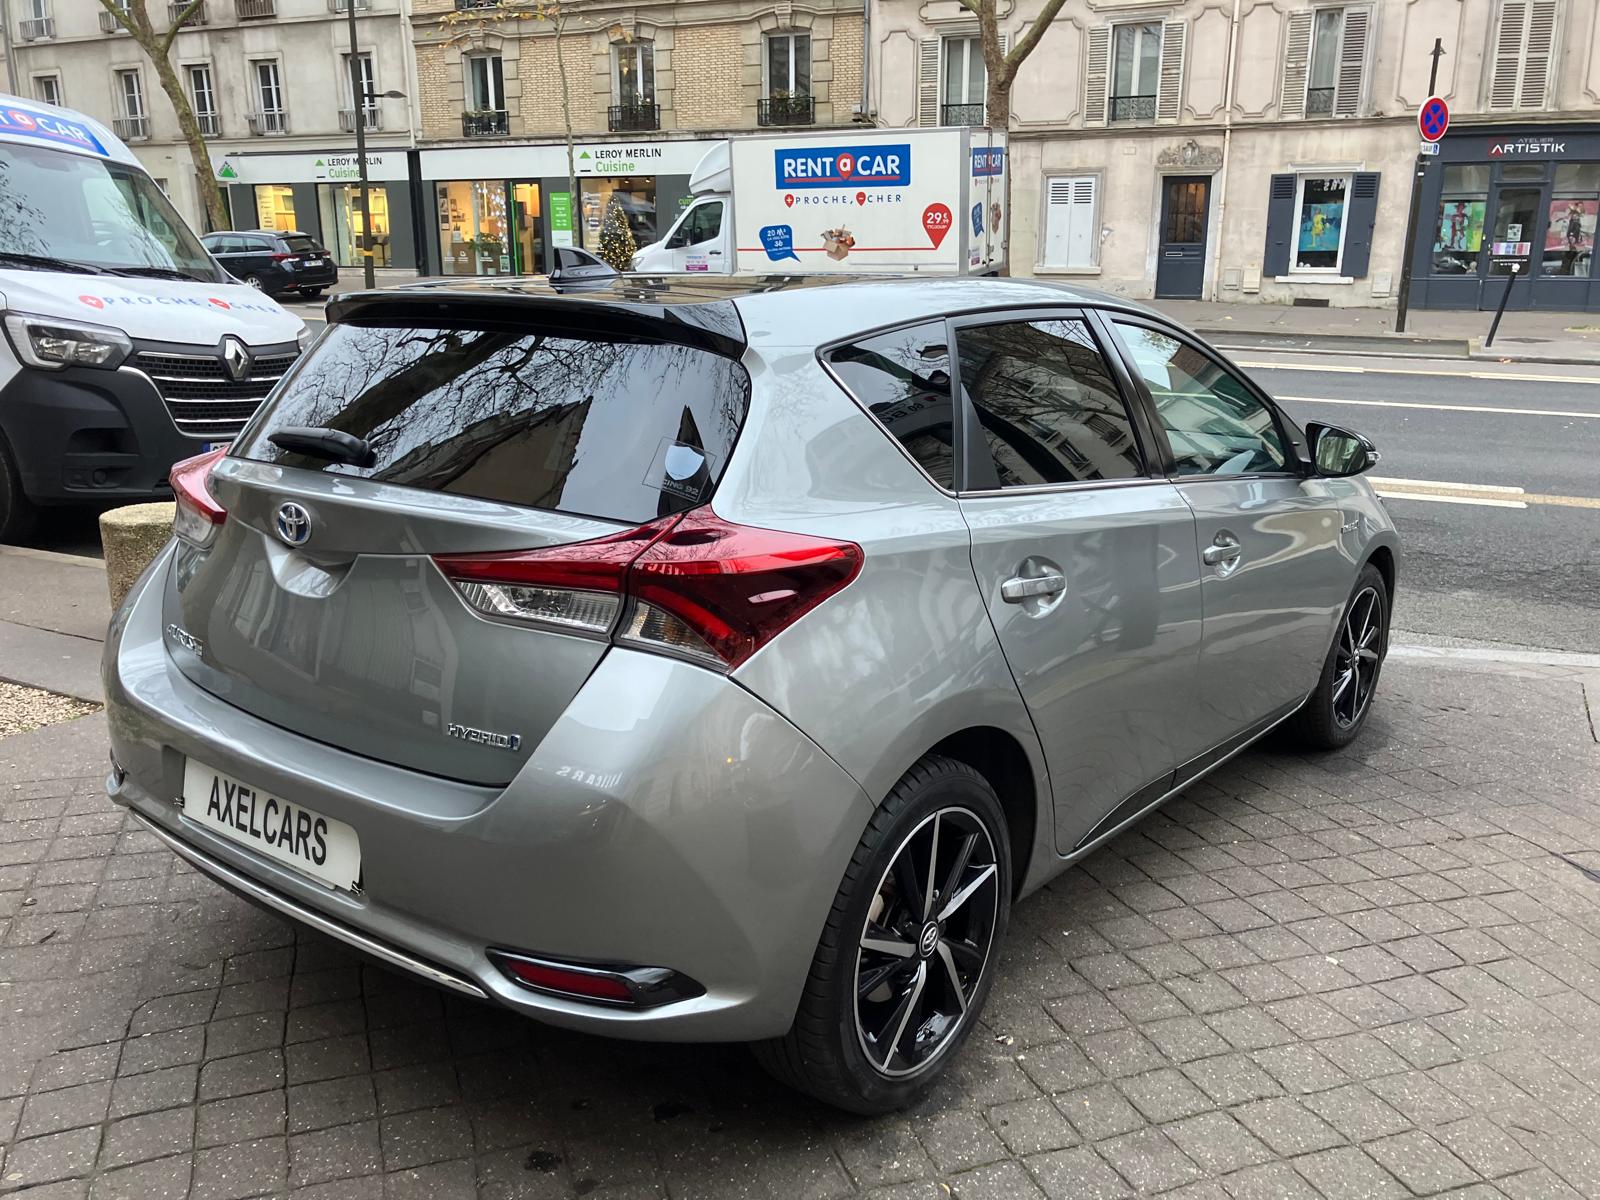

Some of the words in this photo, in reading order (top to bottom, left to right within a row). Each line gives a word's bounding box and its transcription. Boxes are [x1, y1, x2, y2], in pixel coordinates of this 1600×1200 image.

[36, 117, 92, 144] CAR
[595, 149, 623, 159] LEROY
[625, 148, 662, 158] MERLIN
[328, 158, 350, 166] LEROY
[353, 157, 382, 165] MRLIN
[596, 160, 635, 172] Cuisine
[784, 157, 834, 178] RENT
[857, 155, 900, 176] CAR
[867, 194, 901, 203] CHER
[230, 302, 280, 314] CHER
[447, 723, 509, 748] HYBRID
[207, 775, 328, 866] AXELCARS
